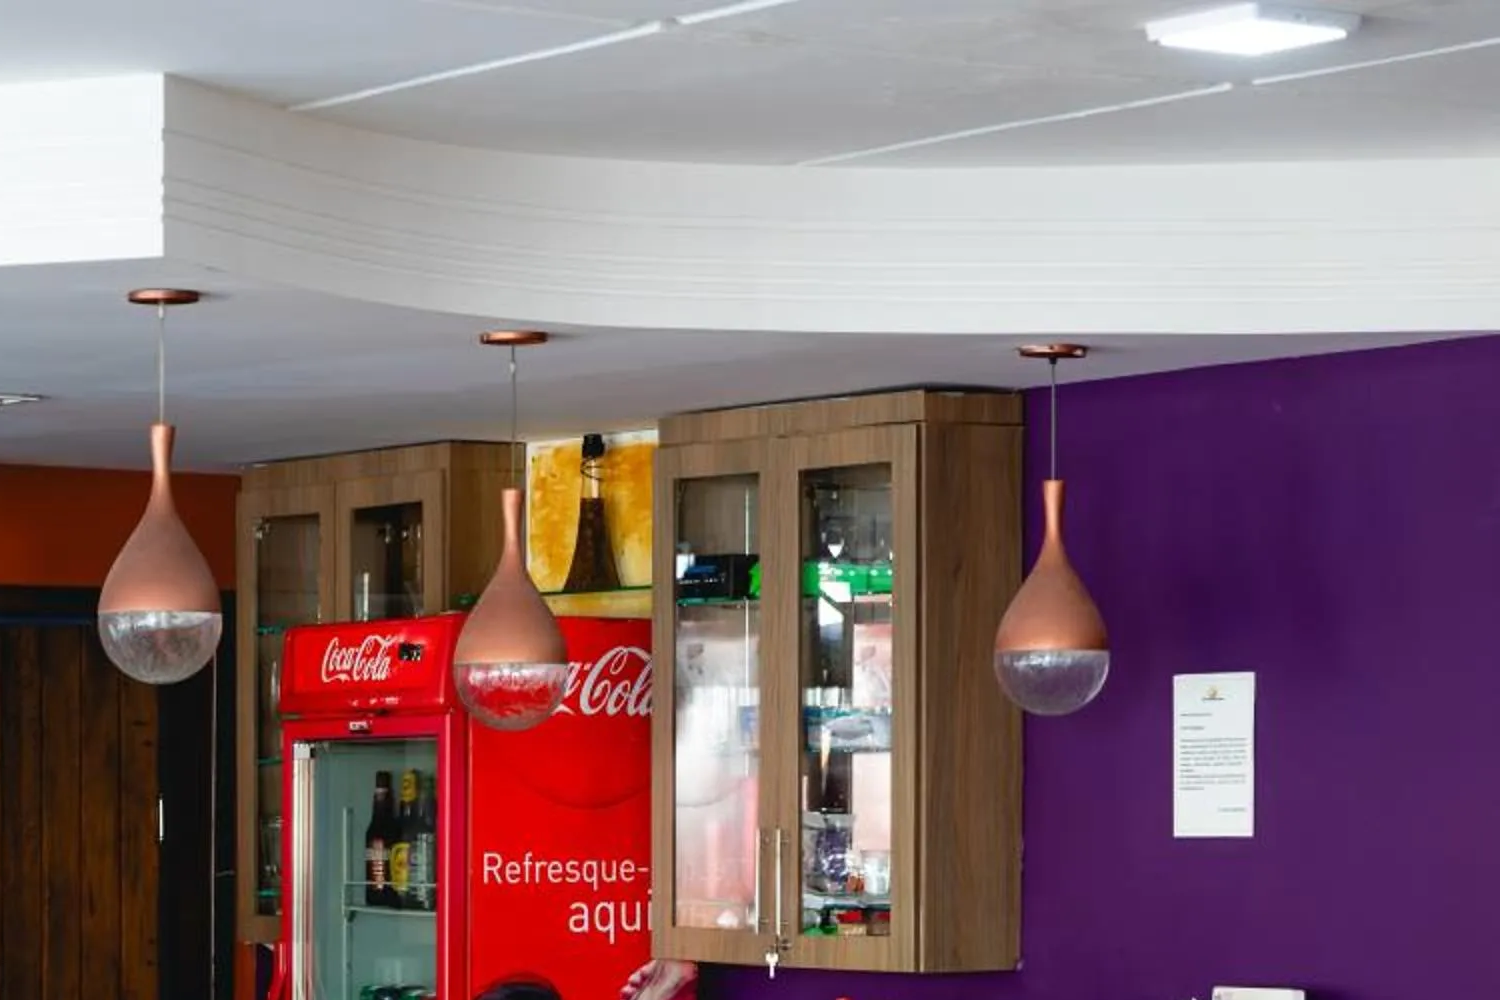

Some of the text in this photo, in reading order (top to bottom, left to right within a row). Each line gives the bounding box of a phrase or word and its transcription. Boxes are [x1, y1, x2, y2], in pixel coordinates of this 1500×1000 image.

[321, 634, 404, 683] Coca-Cola
[483, 852, 649, 891] Refresque-
[568, 889, 652, 944] aqui
